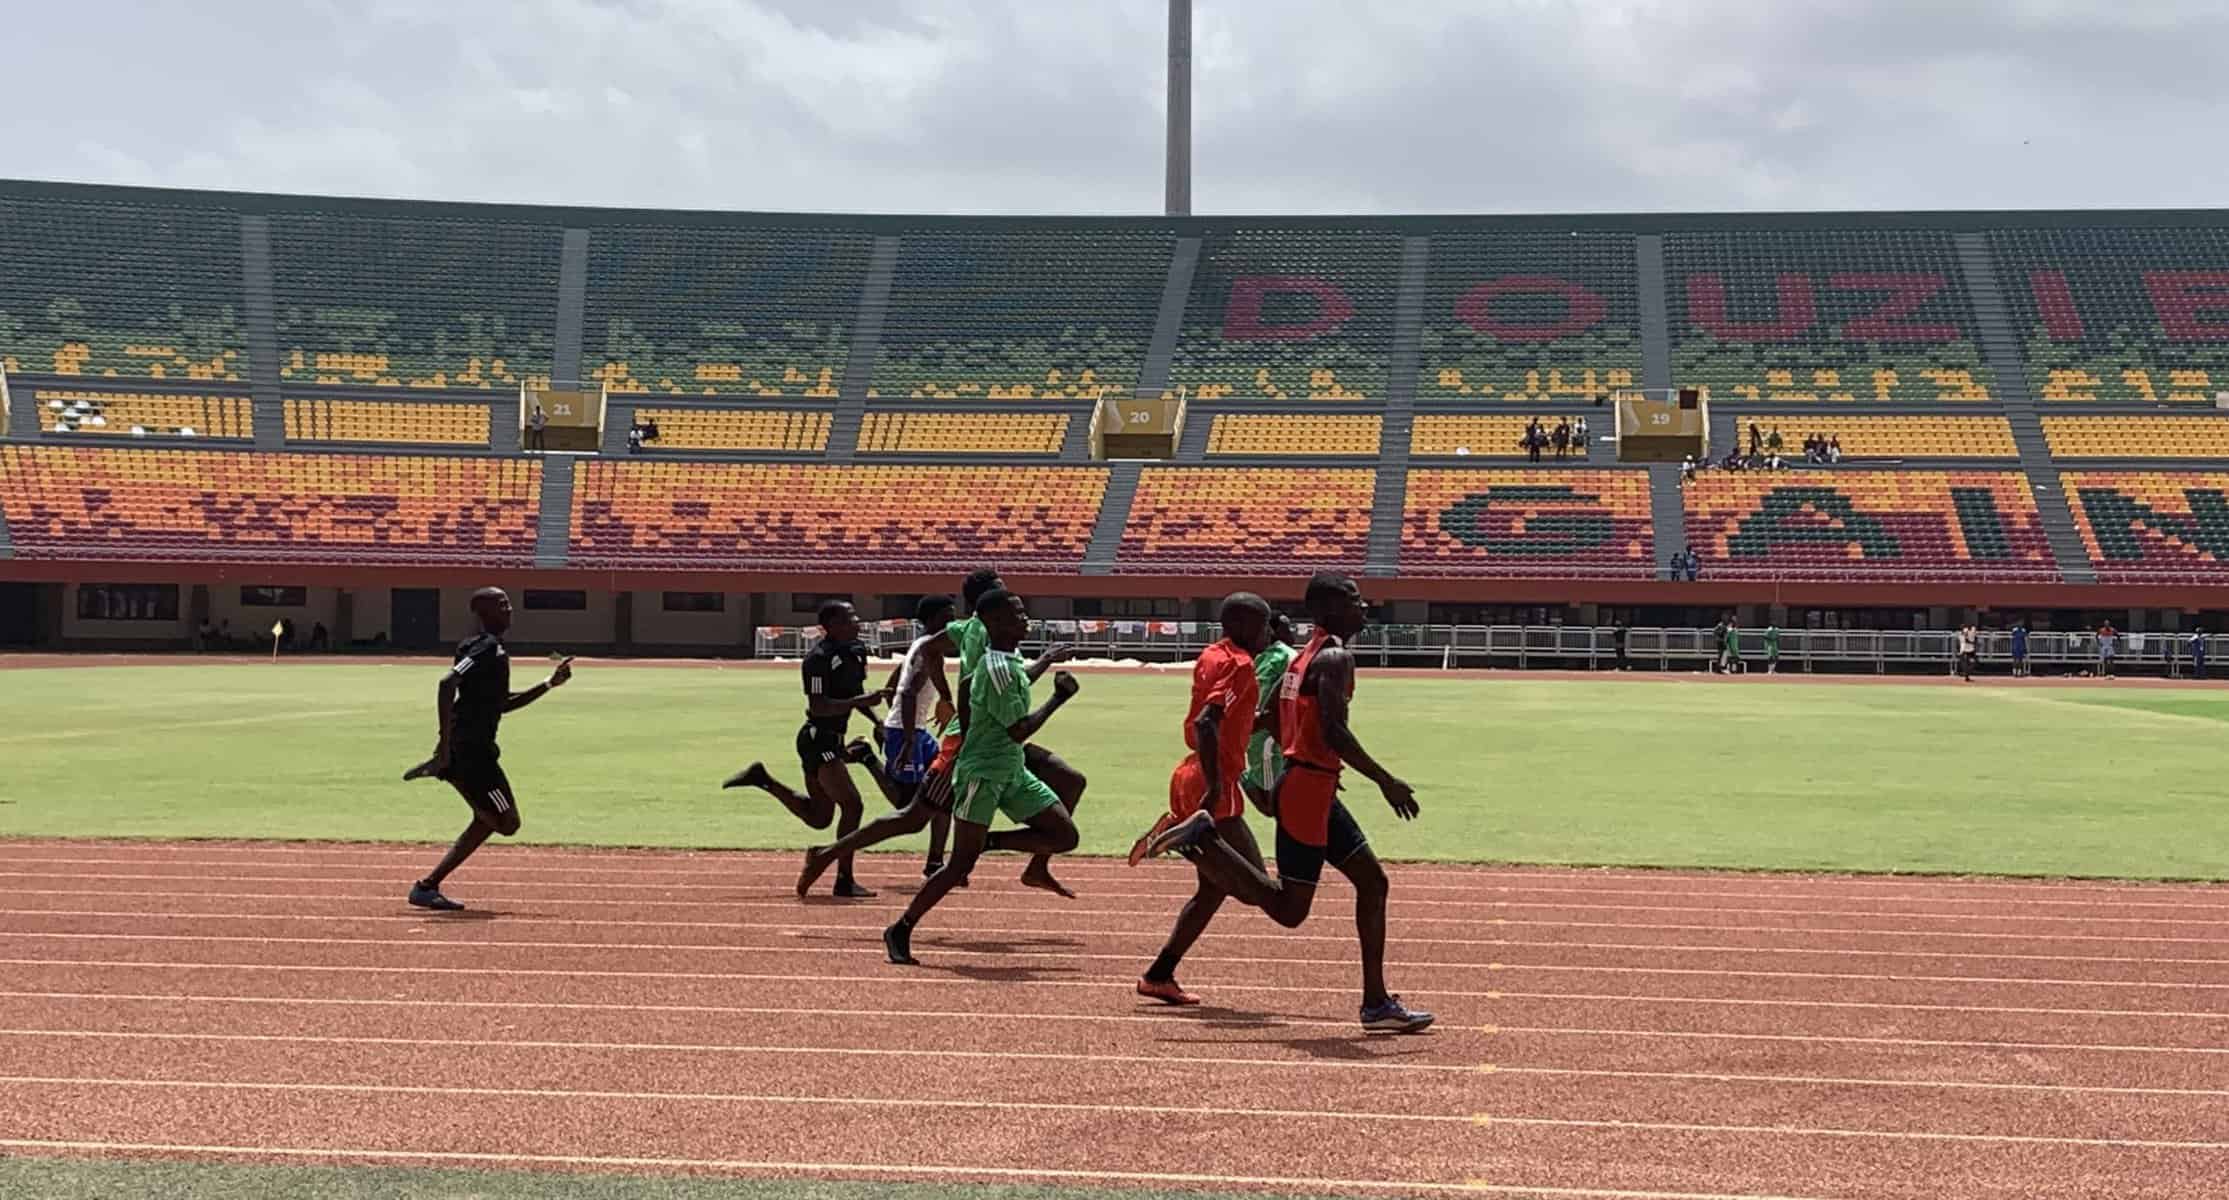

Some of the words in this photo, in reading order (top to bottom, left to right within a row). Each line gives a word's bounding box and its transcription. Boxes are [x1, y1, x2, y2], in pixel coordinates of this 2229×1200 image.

[553, 403, 572, 416] 21
[1129, 411, 1150, 424] 20
[1438, 485, 2229, 560] GAIN
